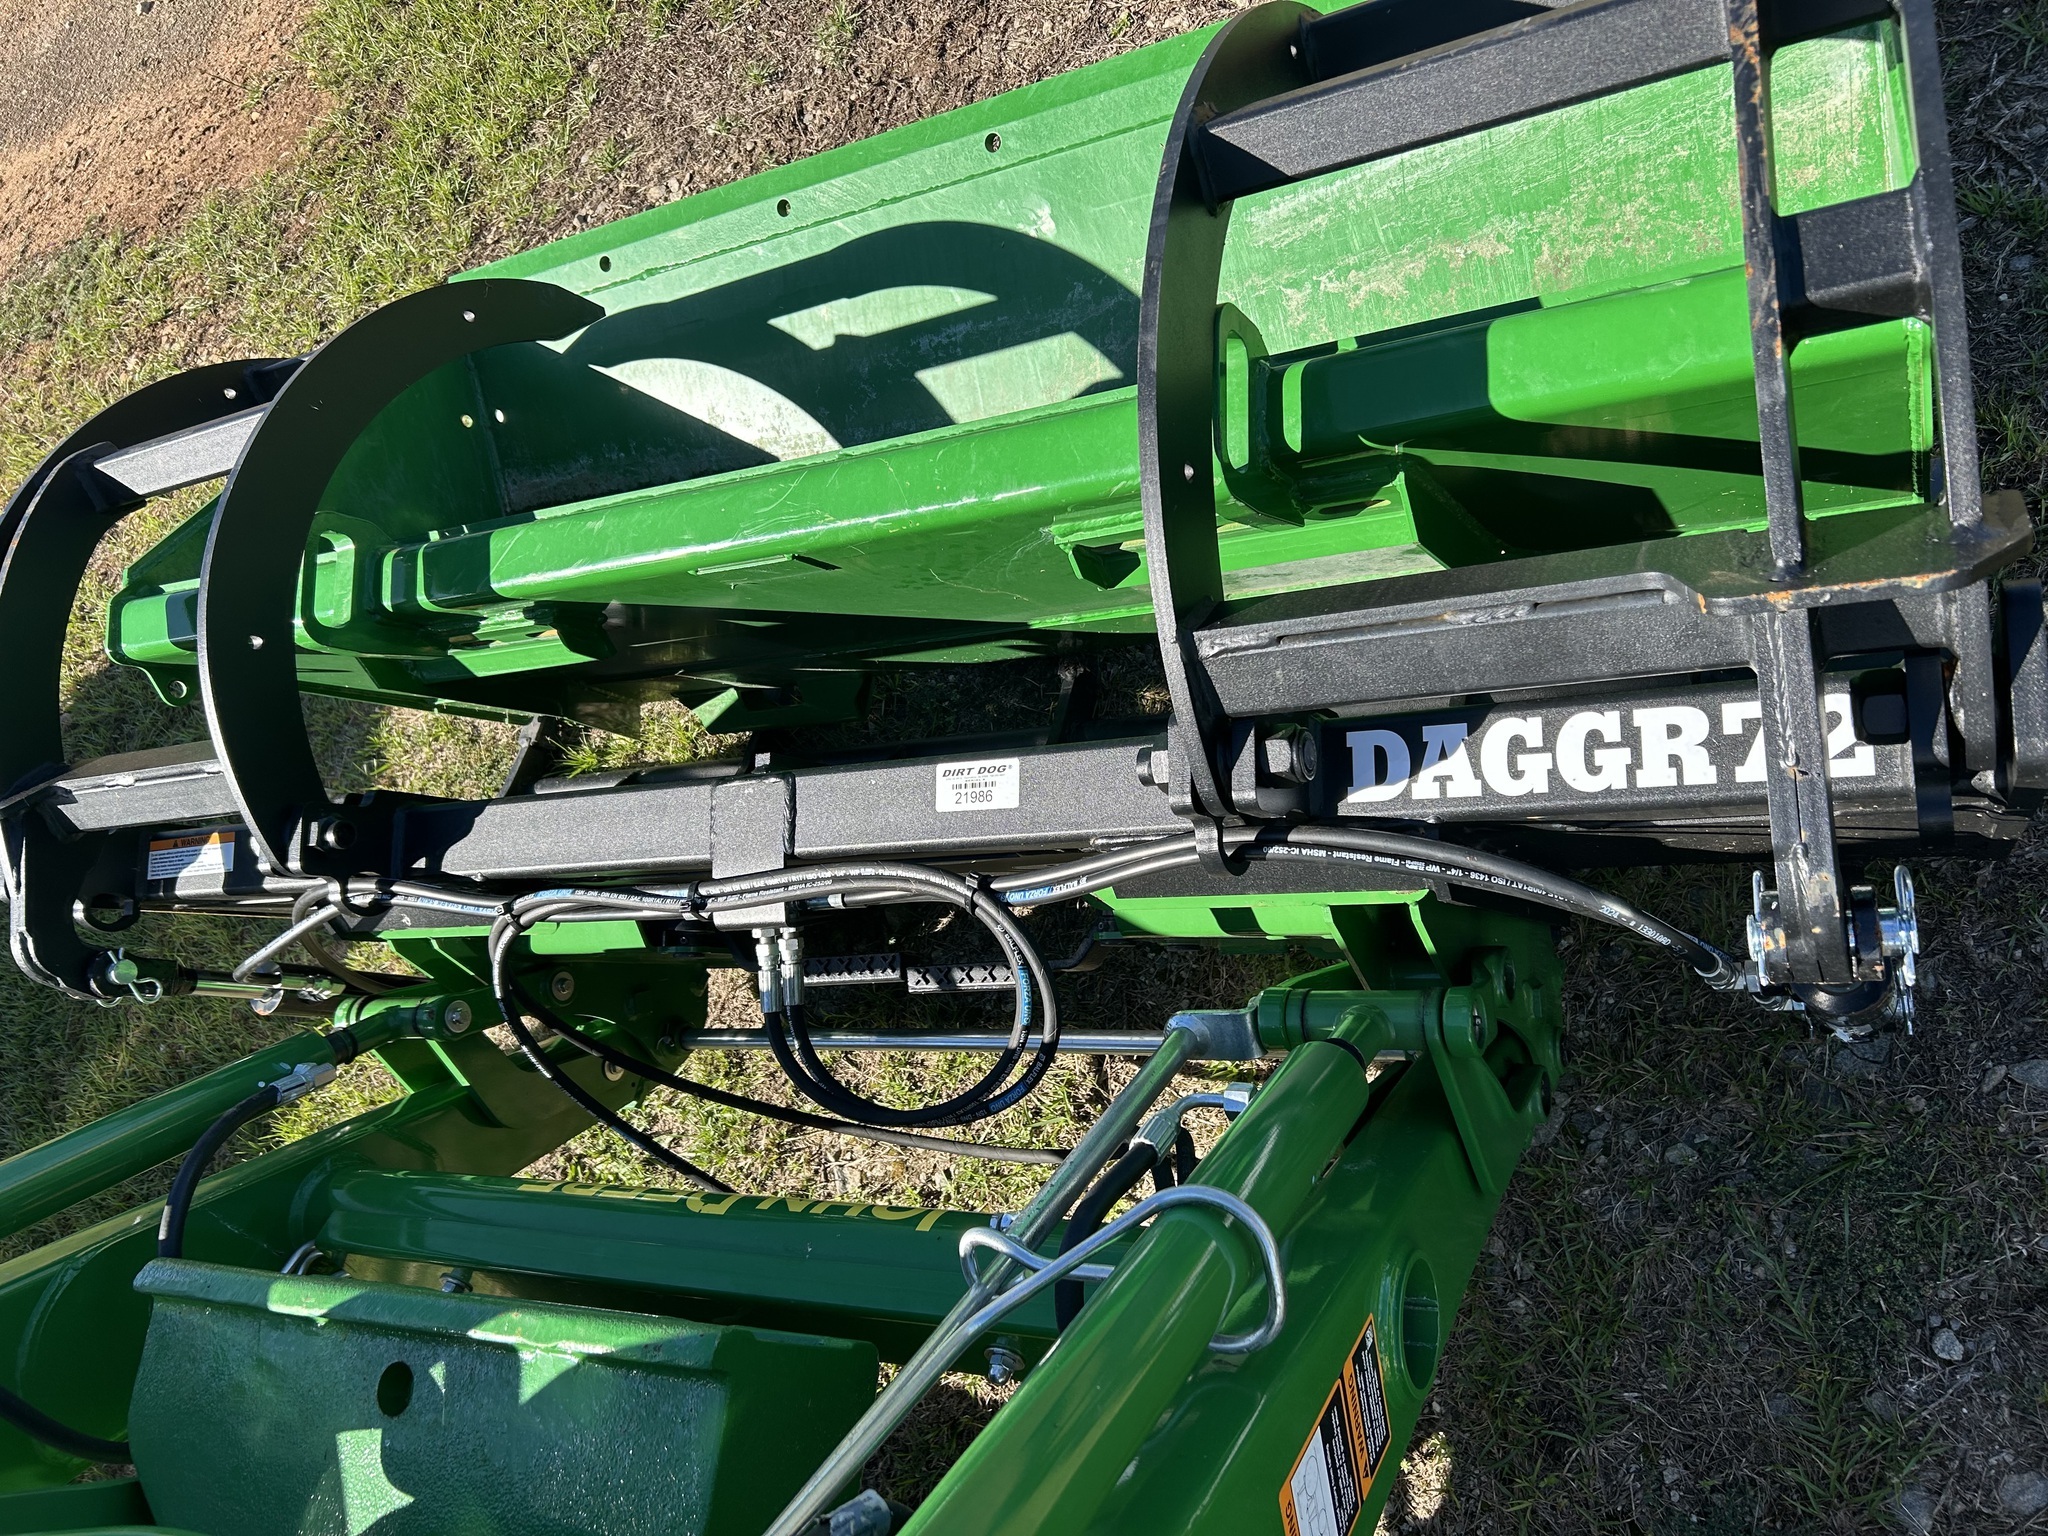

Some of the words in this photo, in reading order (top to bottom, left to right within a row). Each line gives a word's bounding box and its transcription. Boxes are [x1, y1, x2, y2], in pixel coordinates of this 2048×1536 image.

[1346, 693, 1876, 802] DAGGR72
[942, 767, 975, 778] DIRT
[977, 764, 1007, 775] DOG
[955, 789, 993, 805] 21986
[181, 835, 211, 847] WARNING
[1301, 847, 1327, 858] MSHA
[1333, 850, 1373, 863] Resistant
[1374, 856, 1400, 867] Flame
[1425, 864, 1441, 874] WP
[1470, 871, 1490, 882] 1436
[1492, 876, 1507, 886] ISO
[759, 886, 785, 897] Resistant
[788, 882, 806, 892] MSHA
[1009, 891, 1025, 901] UNO
[1024, 886, 1050, 899] FORZA
[1599, 904, 1620, 919] 2024
[1005, 933, 1024, 965] BALFLEX
[1020, 972, 1032, 1003] FORZA
[1023, 1003, 1031, 1024] UNO
[1026, 1062, 1043, 1085] BALFLEX
[1005, 1084, 1027, 1105] FORZA
[990, 1099, 1006, 1112] UNO
[1348, 1372, 1366, 1460] WARNING
